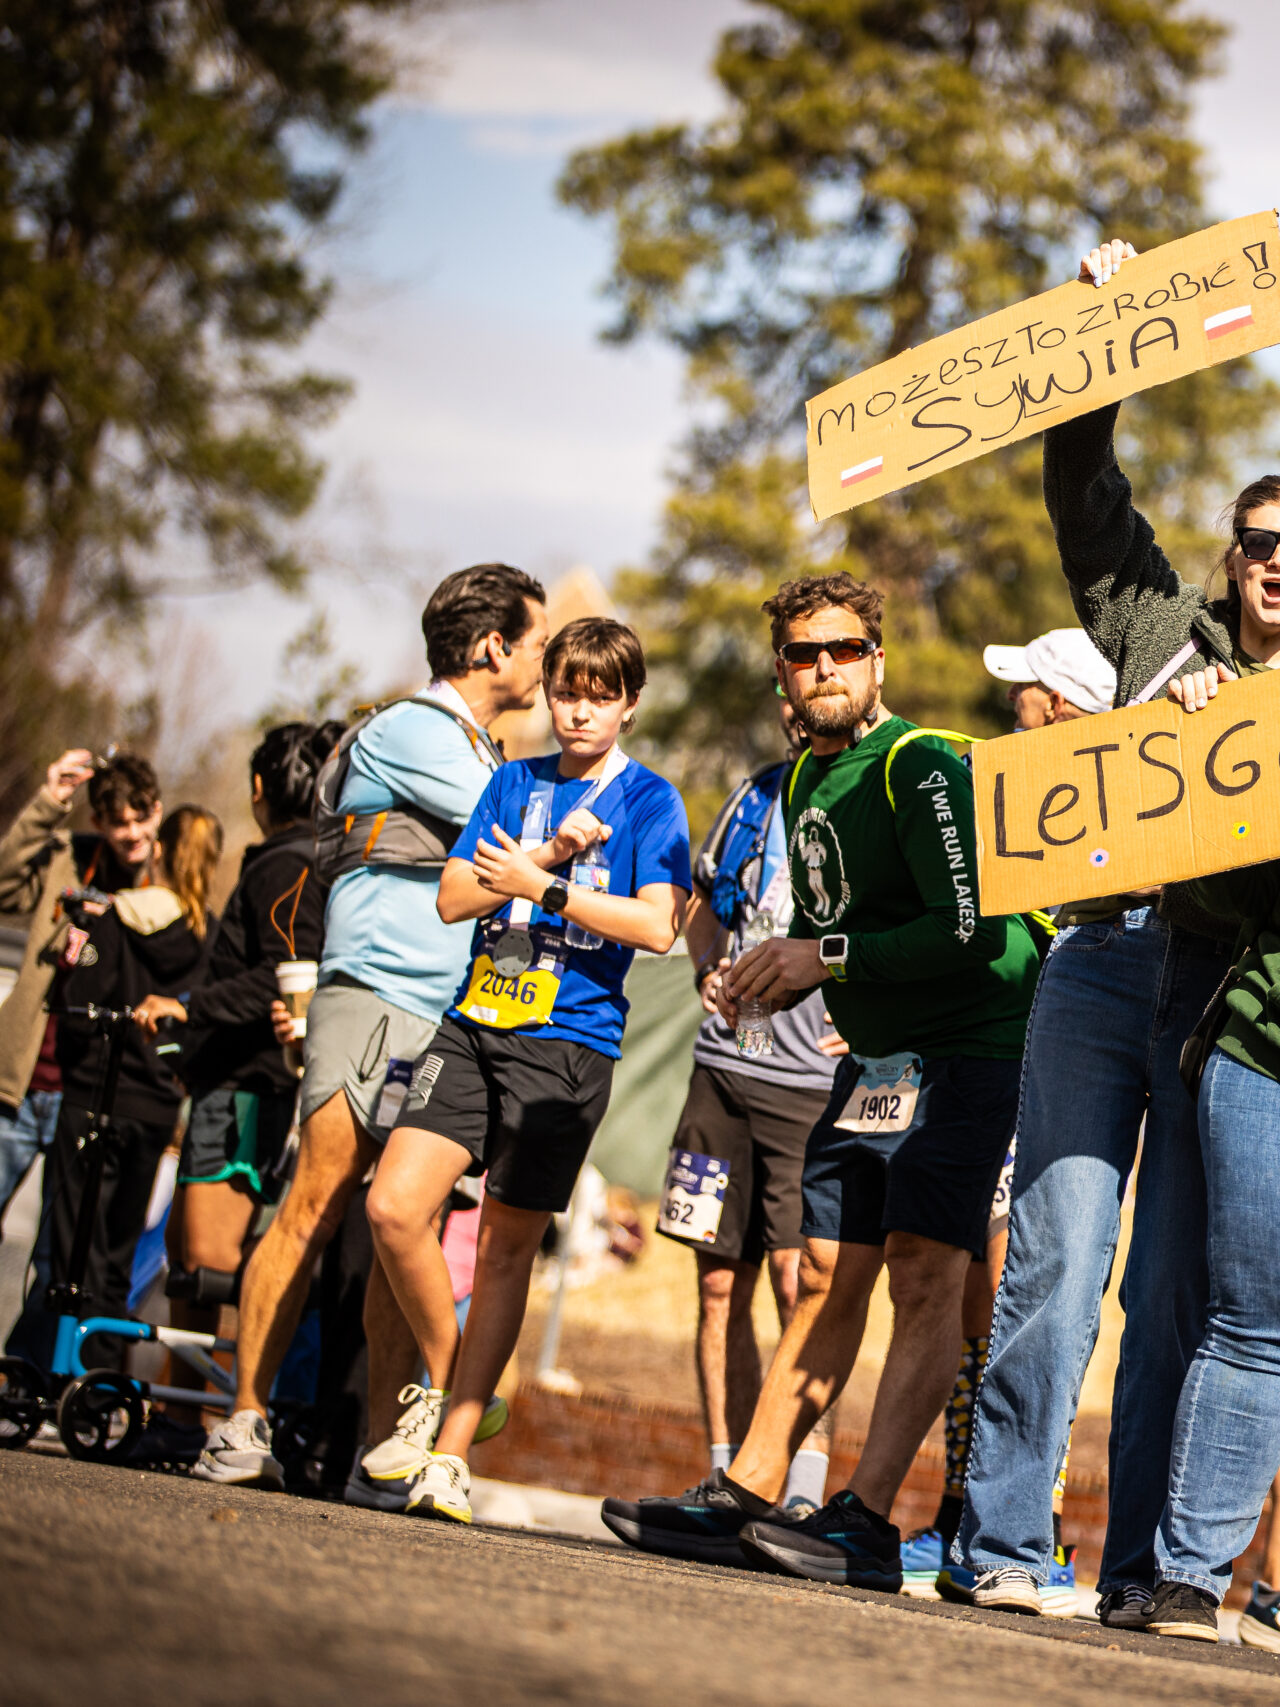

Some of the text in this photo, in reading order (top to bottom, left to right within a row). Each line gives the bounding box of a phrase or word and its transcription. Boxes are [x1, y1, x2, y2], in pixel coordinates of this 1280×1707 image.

[931, 790, 953, 823] WE
[941, 825, 966, 870] RUN
[480, 969, 538, 1005] 2046
[859, 1094, 902, 1120] 1902
